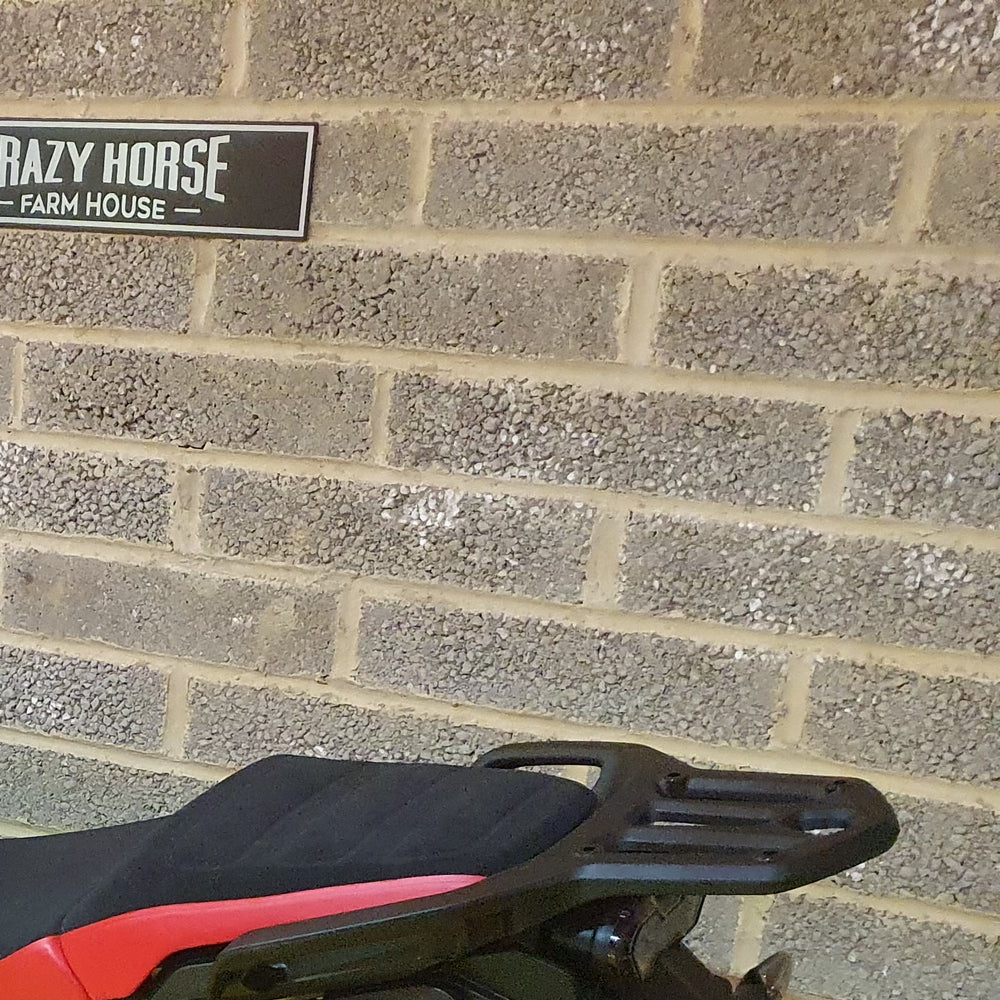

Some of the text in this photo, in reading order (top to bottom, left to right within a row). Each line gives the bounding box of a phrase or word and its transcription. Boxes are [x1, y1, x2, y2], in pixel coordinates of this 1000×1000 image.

[102, 134, 230, 202] HORSE
[20, 192, 166, 220] FARM HOUSE
